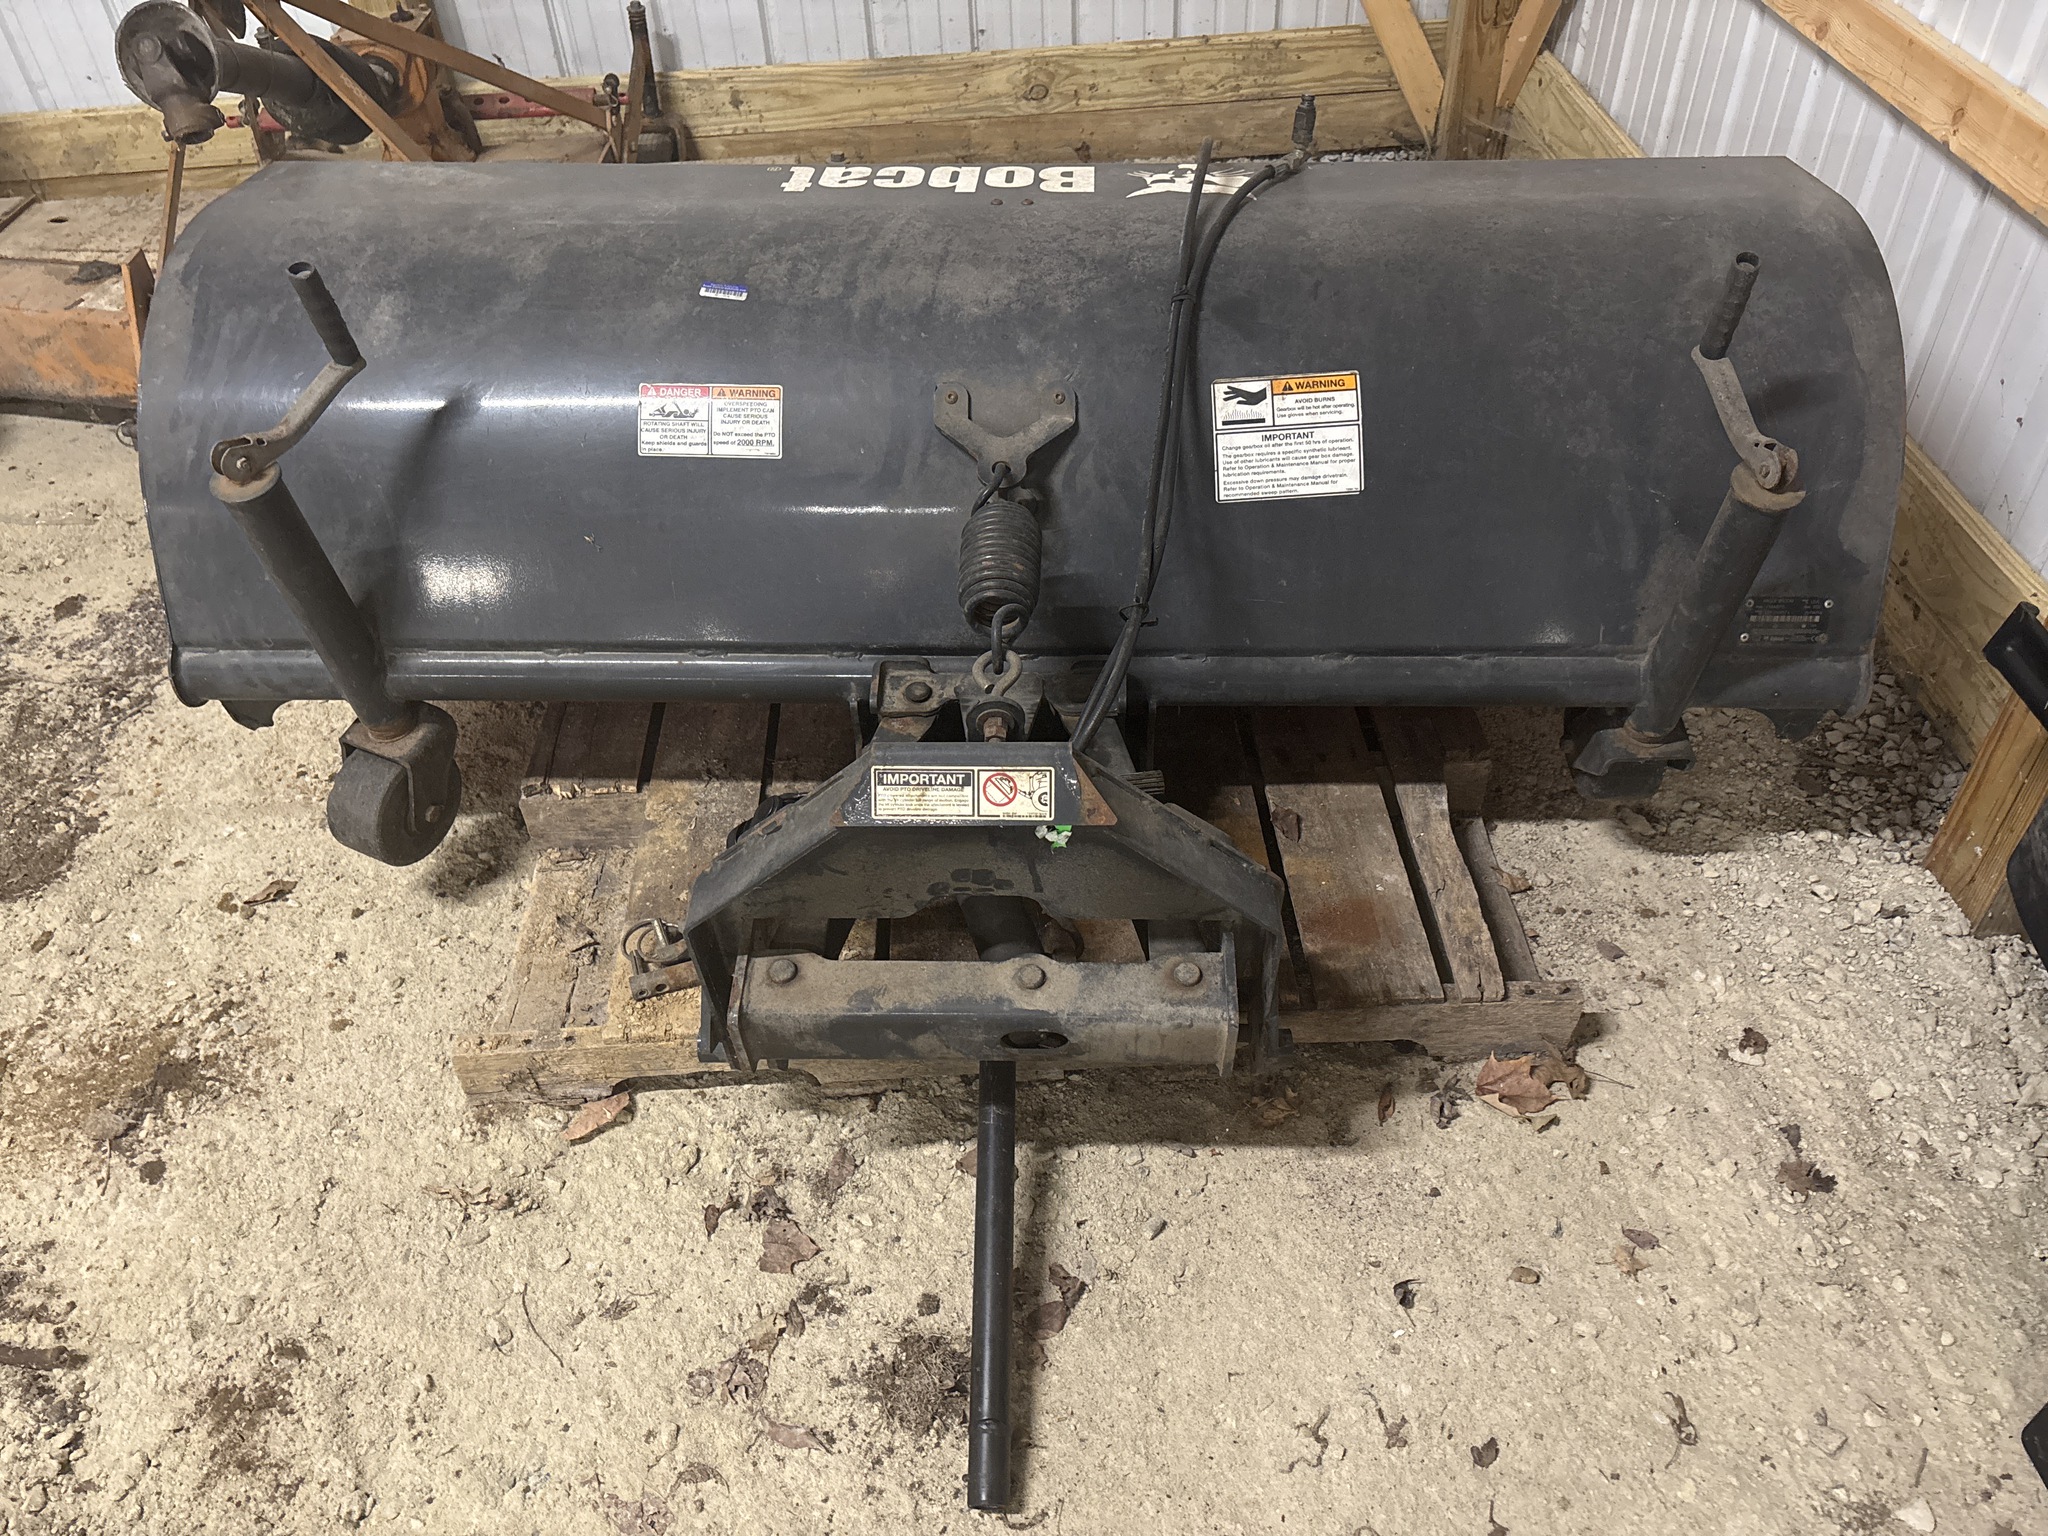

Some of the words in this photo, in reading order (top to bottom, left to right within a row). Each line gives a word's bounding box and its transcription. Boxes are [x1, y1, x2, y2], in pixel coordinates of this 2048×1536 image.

[781, 166, 1095, 192] Bobcat
[1295, 379, 1345, 390] WARNING
[660, 388, 701, 397] DANGER
[729, 389, 776, 398] WARNING
[1262, 431, 1314, 442] IMPORTANT
[756, 439, 774, 447] RPM.
[883, 773, 965, 785] IMPORTANT
